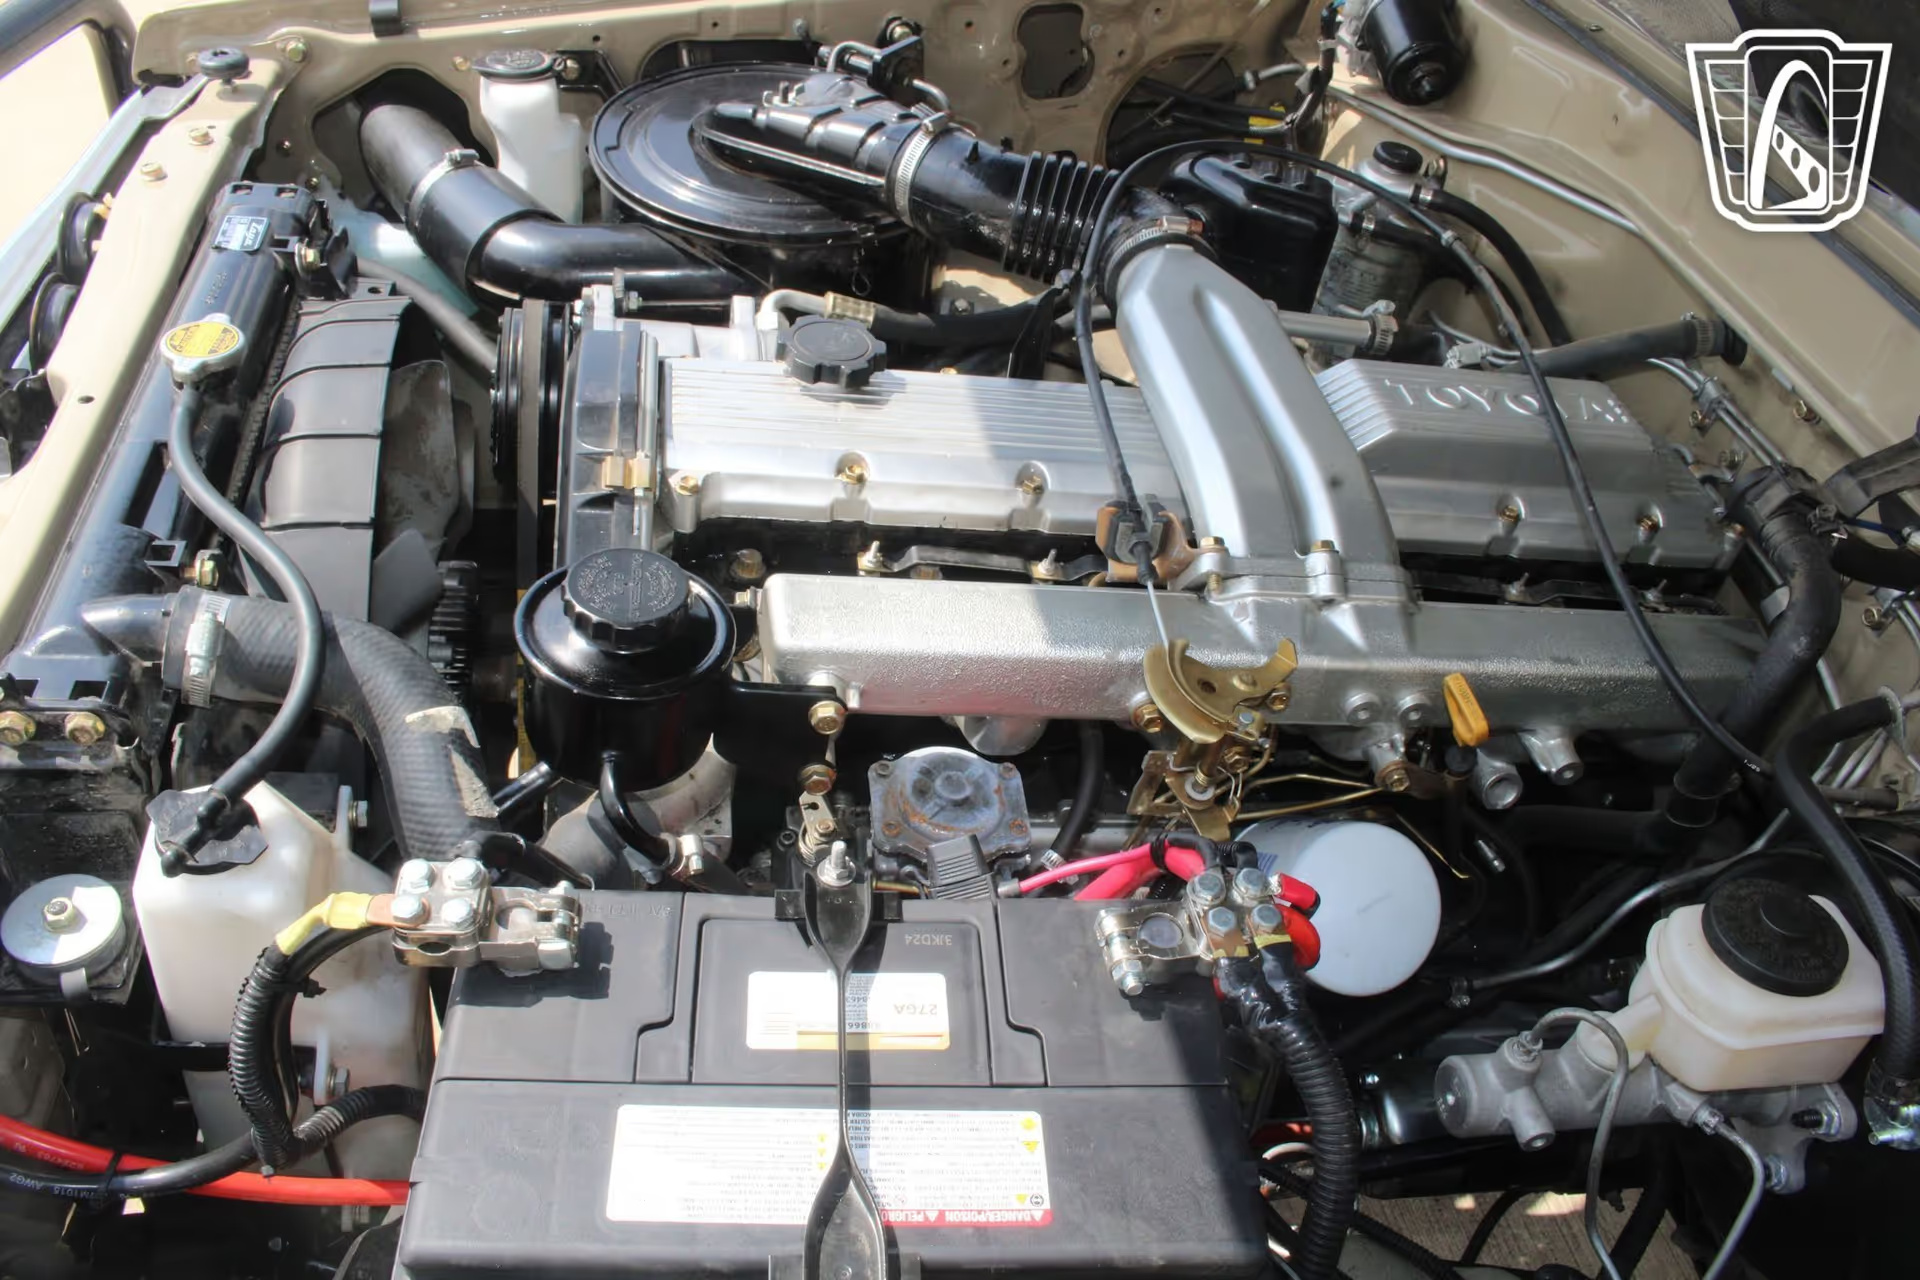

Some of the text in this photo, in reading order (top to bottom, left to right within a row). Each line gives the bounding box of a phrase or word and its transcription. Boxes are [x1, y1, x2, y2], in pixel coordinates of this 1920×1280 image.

[8, 1172, 44, 1191] AWG2
[879, 1209, 1032, 1222] PELIGRO DANGER/POISON
